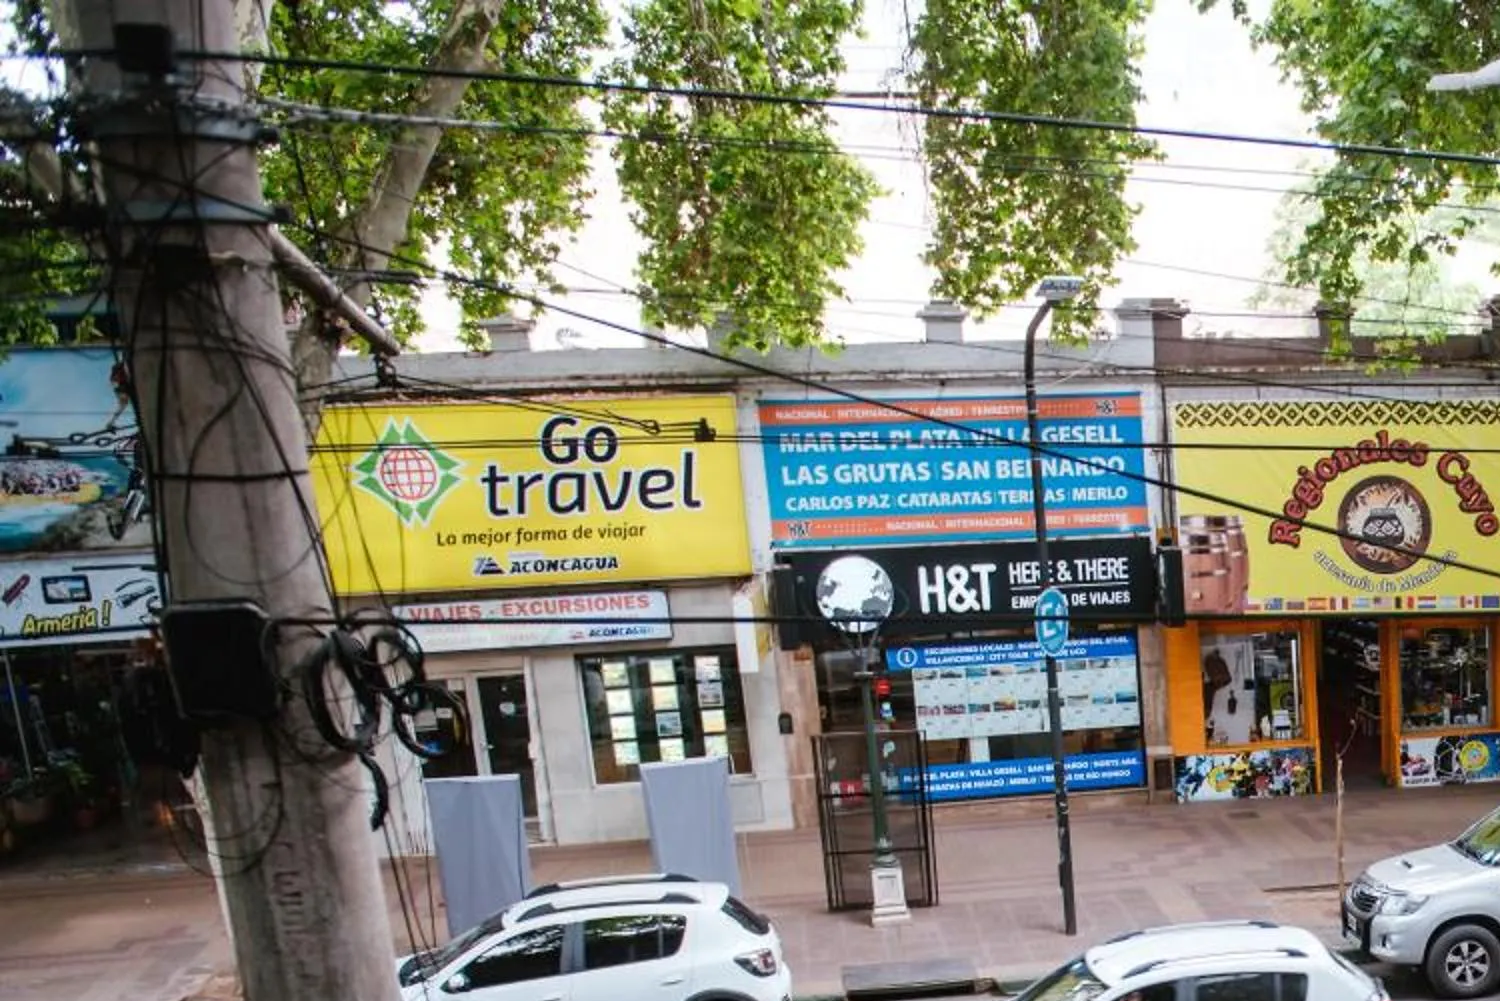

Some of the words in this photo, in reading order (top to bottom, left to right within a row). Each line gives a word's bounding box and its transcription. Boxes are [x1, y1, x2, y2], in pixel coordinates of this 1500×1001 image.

[540, 415, 618, 465] Go
[779, 431, 836, 453] MAR
[839, 430, 887, 452] DEL
[890, 427, 961, 451] PLATA
[1041, 424, 1125, 444] GESELL
[480, 451, 702, 517] travel
[782, 464, 829, 486] LAS
[834, 461, 931, 485] GRUTAS
[941, 459, 990, 481] SAN
[785, 495, 854, 512] CARLOS
[857, 493, 891, 509] PAZ
[897, 490, 992, 508] CATARATAS
[999, 487, 1065, 505] TERAS
[1072, 486, 1128, 501] MERLO
[1267, 429, 1431, 549] Regionales
[1436, 450, 1500, 536] Cuyo
[436, 532, 458, 546] La
[461, 530, 511, 548] mejor
[515, 526, 568, 546] forma
[572, 524, 594, 541] de
[598, 522, 647, 541] viajar
[510, 555, 620, 575] ACONCAGUA
[1057, 559, 1073, 582] &
[1074, 556, 1130, 581] THERE
[917, 562, 997, 615] H&T
[1071, 592, 1087, 606] DE
[1088, 590, 1131, 605] VIAJES
[407, 602, 482, 624] VIAJES
[501, 593, 650, 618] EXCURSIONES
